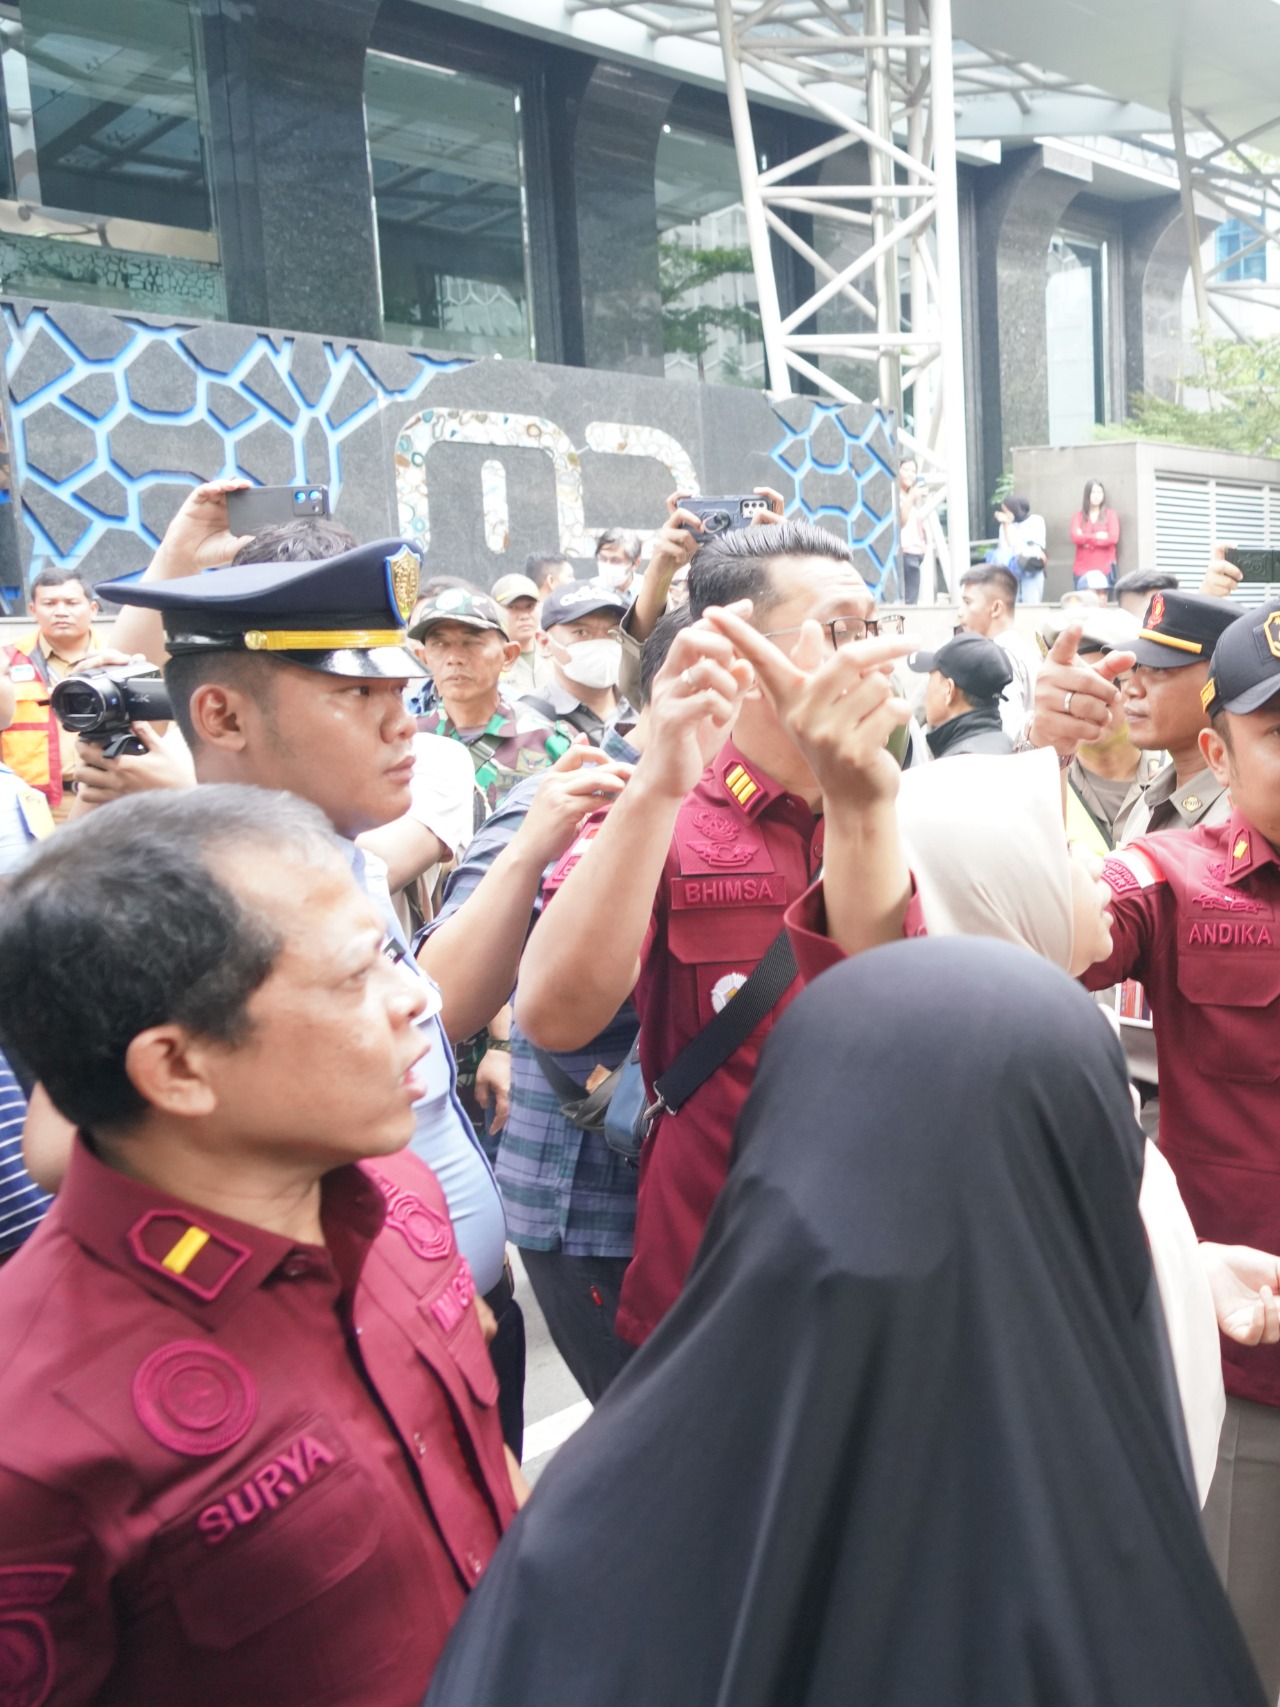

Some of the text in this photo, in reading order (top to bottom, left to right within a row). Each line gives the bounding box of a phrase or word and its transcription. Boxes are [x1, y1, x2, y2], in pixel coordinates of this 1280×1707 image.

[685, 879, 774, 903] BHIMSA
[1188, 923, 1274, 946] ANDIKA
[197, 1436, 336, 1545] SURYA
